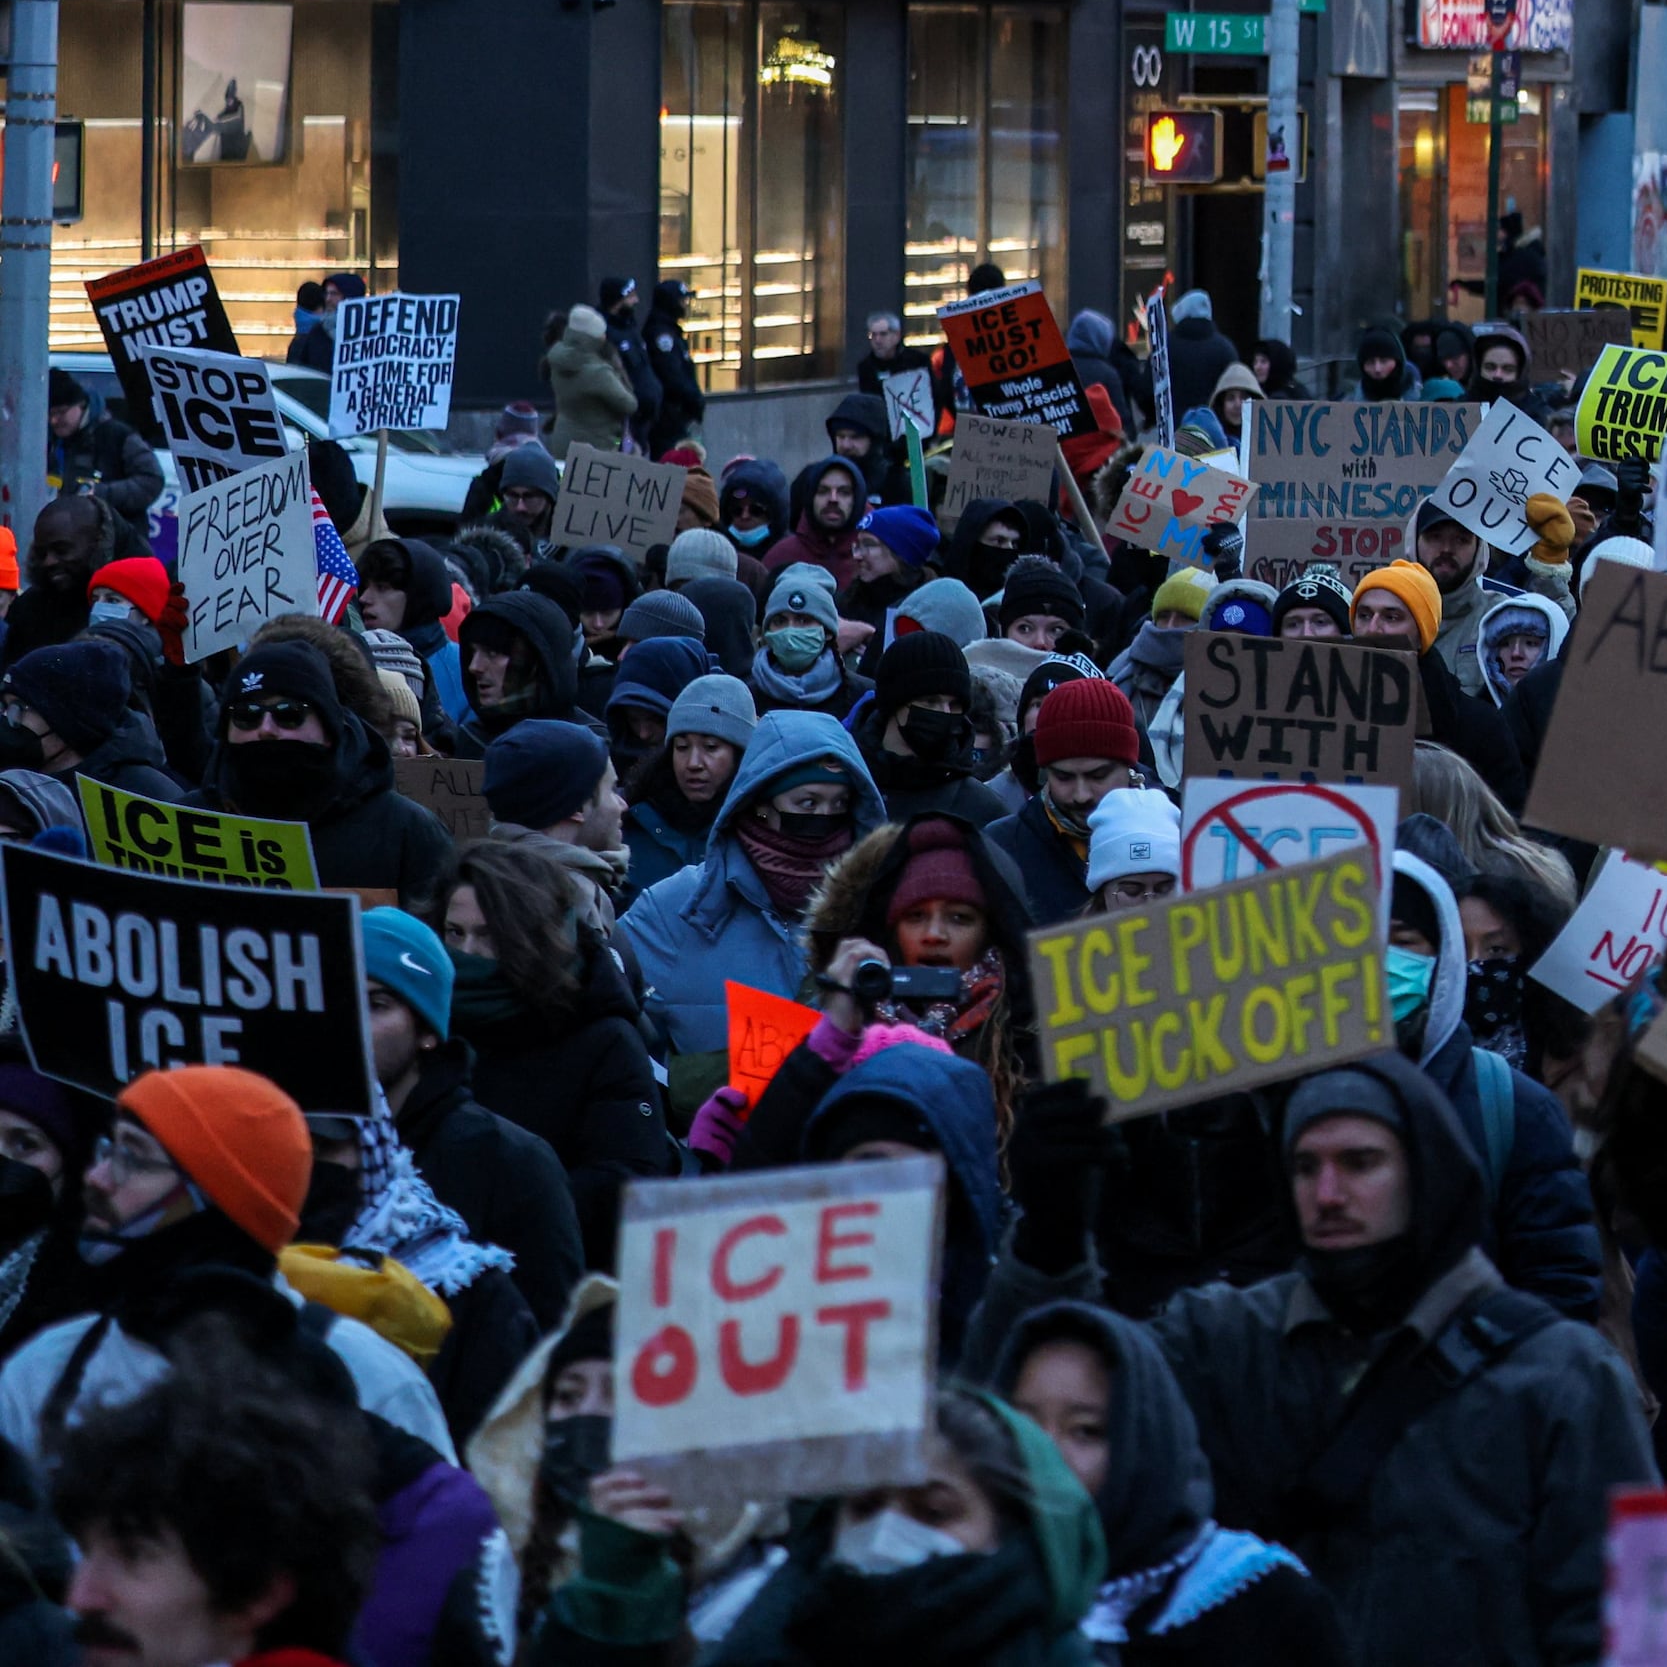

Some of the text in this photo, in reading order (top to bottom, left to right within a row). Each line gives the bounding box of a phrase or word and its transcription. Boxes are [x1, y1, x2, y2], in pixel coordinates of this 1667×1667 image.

[1174, 20, 1260, 48] W 15 St
[99, 276, 209, 333] TRUMP
[1579, 275, 1664, 304] PROTESTING
[121, 312, 208, 363] MUST
[343, 298, 457, 342] DEFEND
[965, 318, 1044, 360] MUST
[971, 301, 1020, 333] ICE
[338, 333, 454, 365] DEMOCRACY:
[987, 346, 1040, 376] GO!
[149, 356, 268, 405] STOP
[336, 362, 452, 393] IT'S TIME FOR
[345, 382, 438, 414] A GENERAL
[982, 381, 1078, 420] Trump Fascist
[999, 375, 1043, 400] Whole
[158, 392, 290, 458] ICE
[355, 405, 425, 432] STRIKE!
[967, 419, 1035, 445] POWER
[1256, 403, 1469, 458] NYC STANDS
[1144, 449, 1208, 488] NY
[1341, 457, 1377, 479] with
[1494, 413, 1570, 490] ICE
[565, 456, 672, 512] LET MN
[182, 460, 308, 568] FREEDOM
[564, 503, 655, 548] LIVE
[1449, 478, 1532, 545] OUT
[213, 523, 285, 581] OVER
[1311, 526, 1403, 558] STOP
[192, 566, 295, 650] FEAR
[1198, 636, 1412, 727] STAND
[1200, 713, 1380, 773] WITH
[100, 787, 228, 870] ICE
[239, 829, 287, 875] is
[33, 893, 326, 1013] ABOLISH
[1035, 859, 1375, 1030] ICE PUNKS
[106, 999, 243, 1085] ICE
[1044, 950, 1383, 1103] FUCK OFF!
[650, 1201, 882, 1308] ICE
[628, 1298, 892, 1409] OUT
